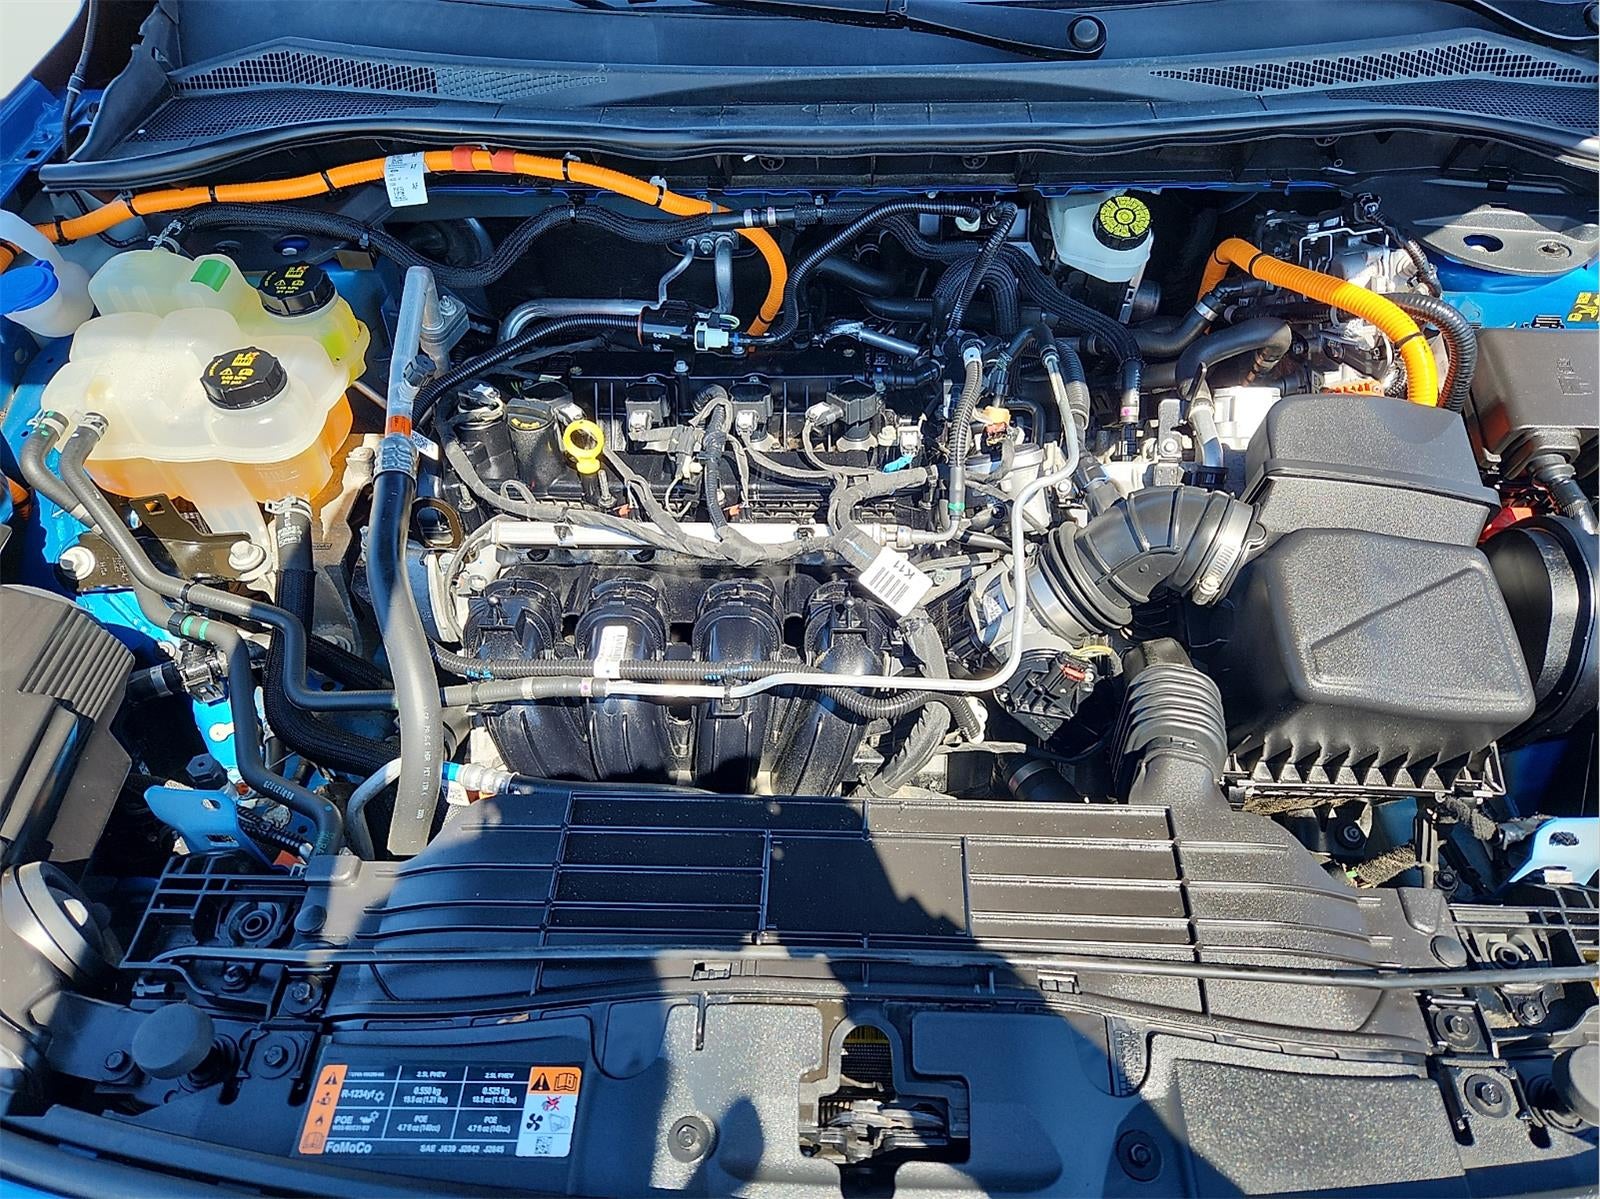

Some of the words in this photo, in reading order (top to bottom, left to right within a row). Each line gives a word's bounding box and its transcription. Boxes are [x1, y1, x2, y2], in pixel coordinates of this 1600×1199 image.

[893, 560, 915, 580] K11
[341, 1089, 376, 1100] R-1234yf
[432, 1086, 442, 1096] kg
[500, 1086, 510, 1096] kg
[334, 1115, 353, 1124] POE
[413, 1115, 428, 1123] POE
[483, 1116, 498, 1124] POE
[325, 1141, 372, 1154] FoMoCo
[420, 1144, 436, 1152] SAE
